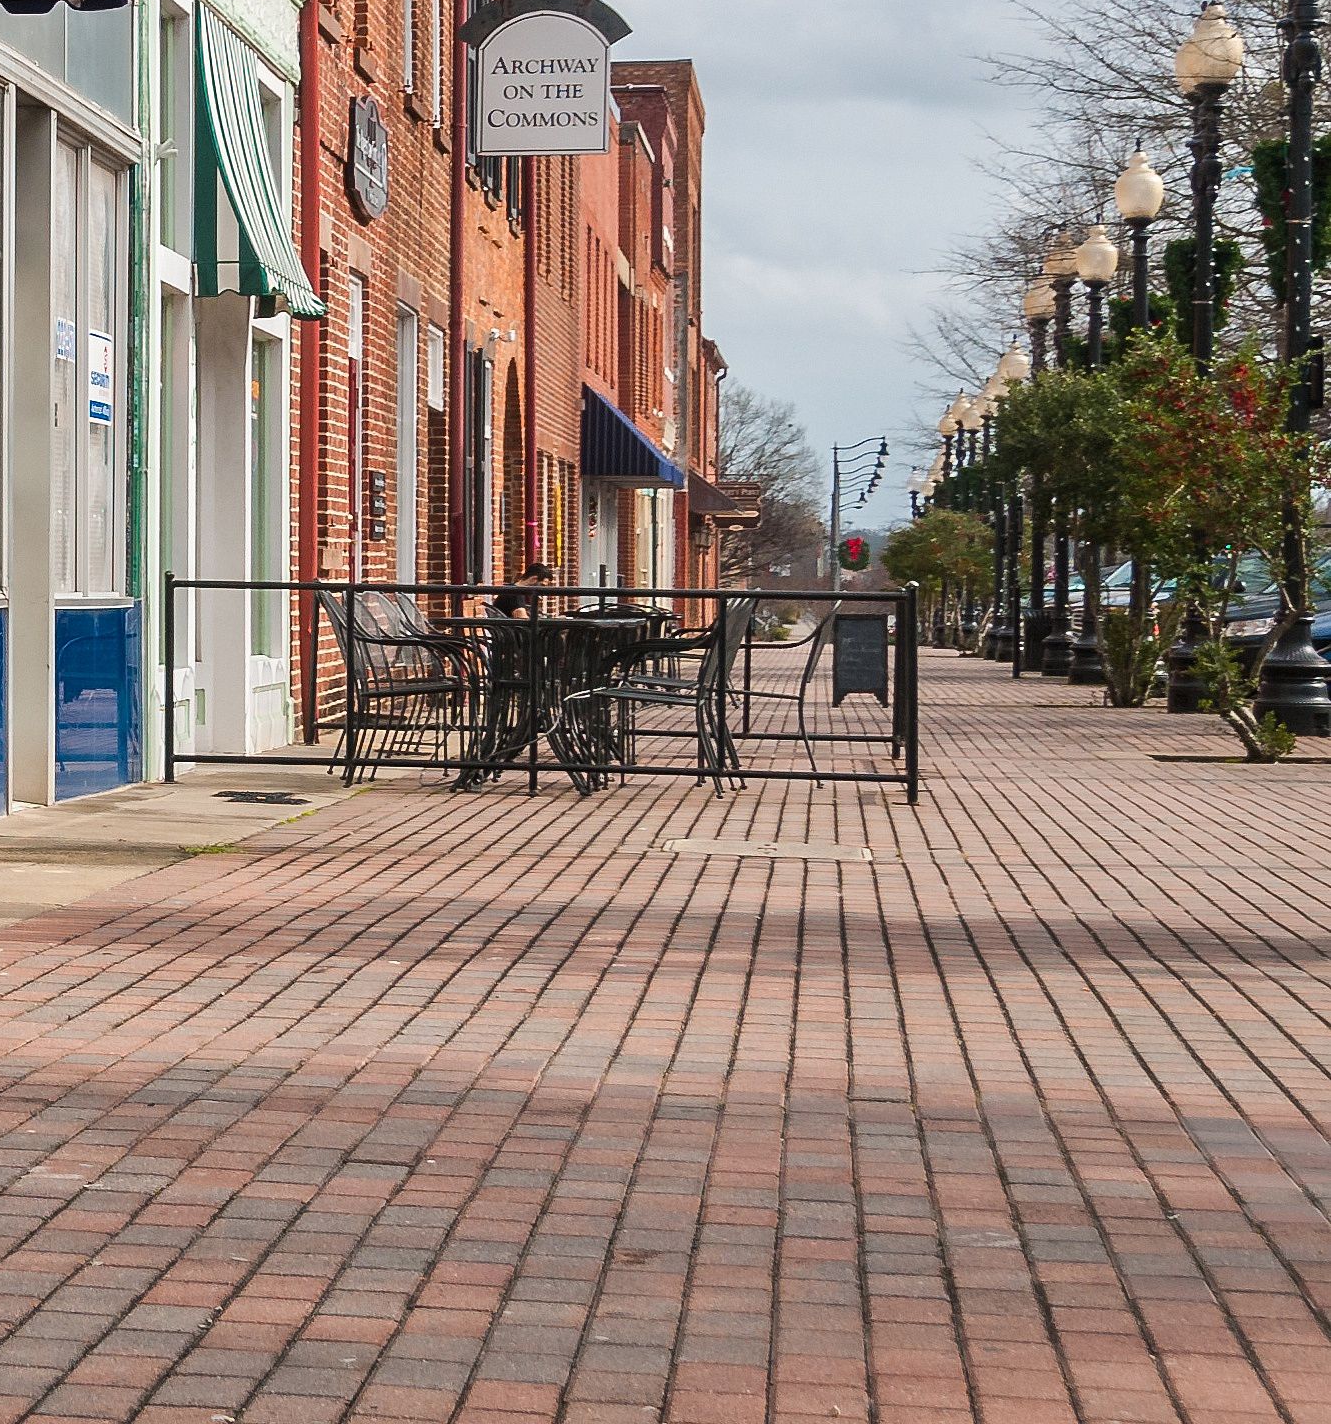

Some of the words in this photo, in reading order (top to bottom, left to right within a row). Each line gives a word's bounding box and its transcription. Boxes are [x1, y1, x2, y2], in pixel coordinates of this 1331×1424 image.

[491, 56, 598, 74] ARCHWAY
[503, 84, 535, 100] ON
[540, 83, 584, 99] THE
[487, 108, 598, 128] COMMONS
